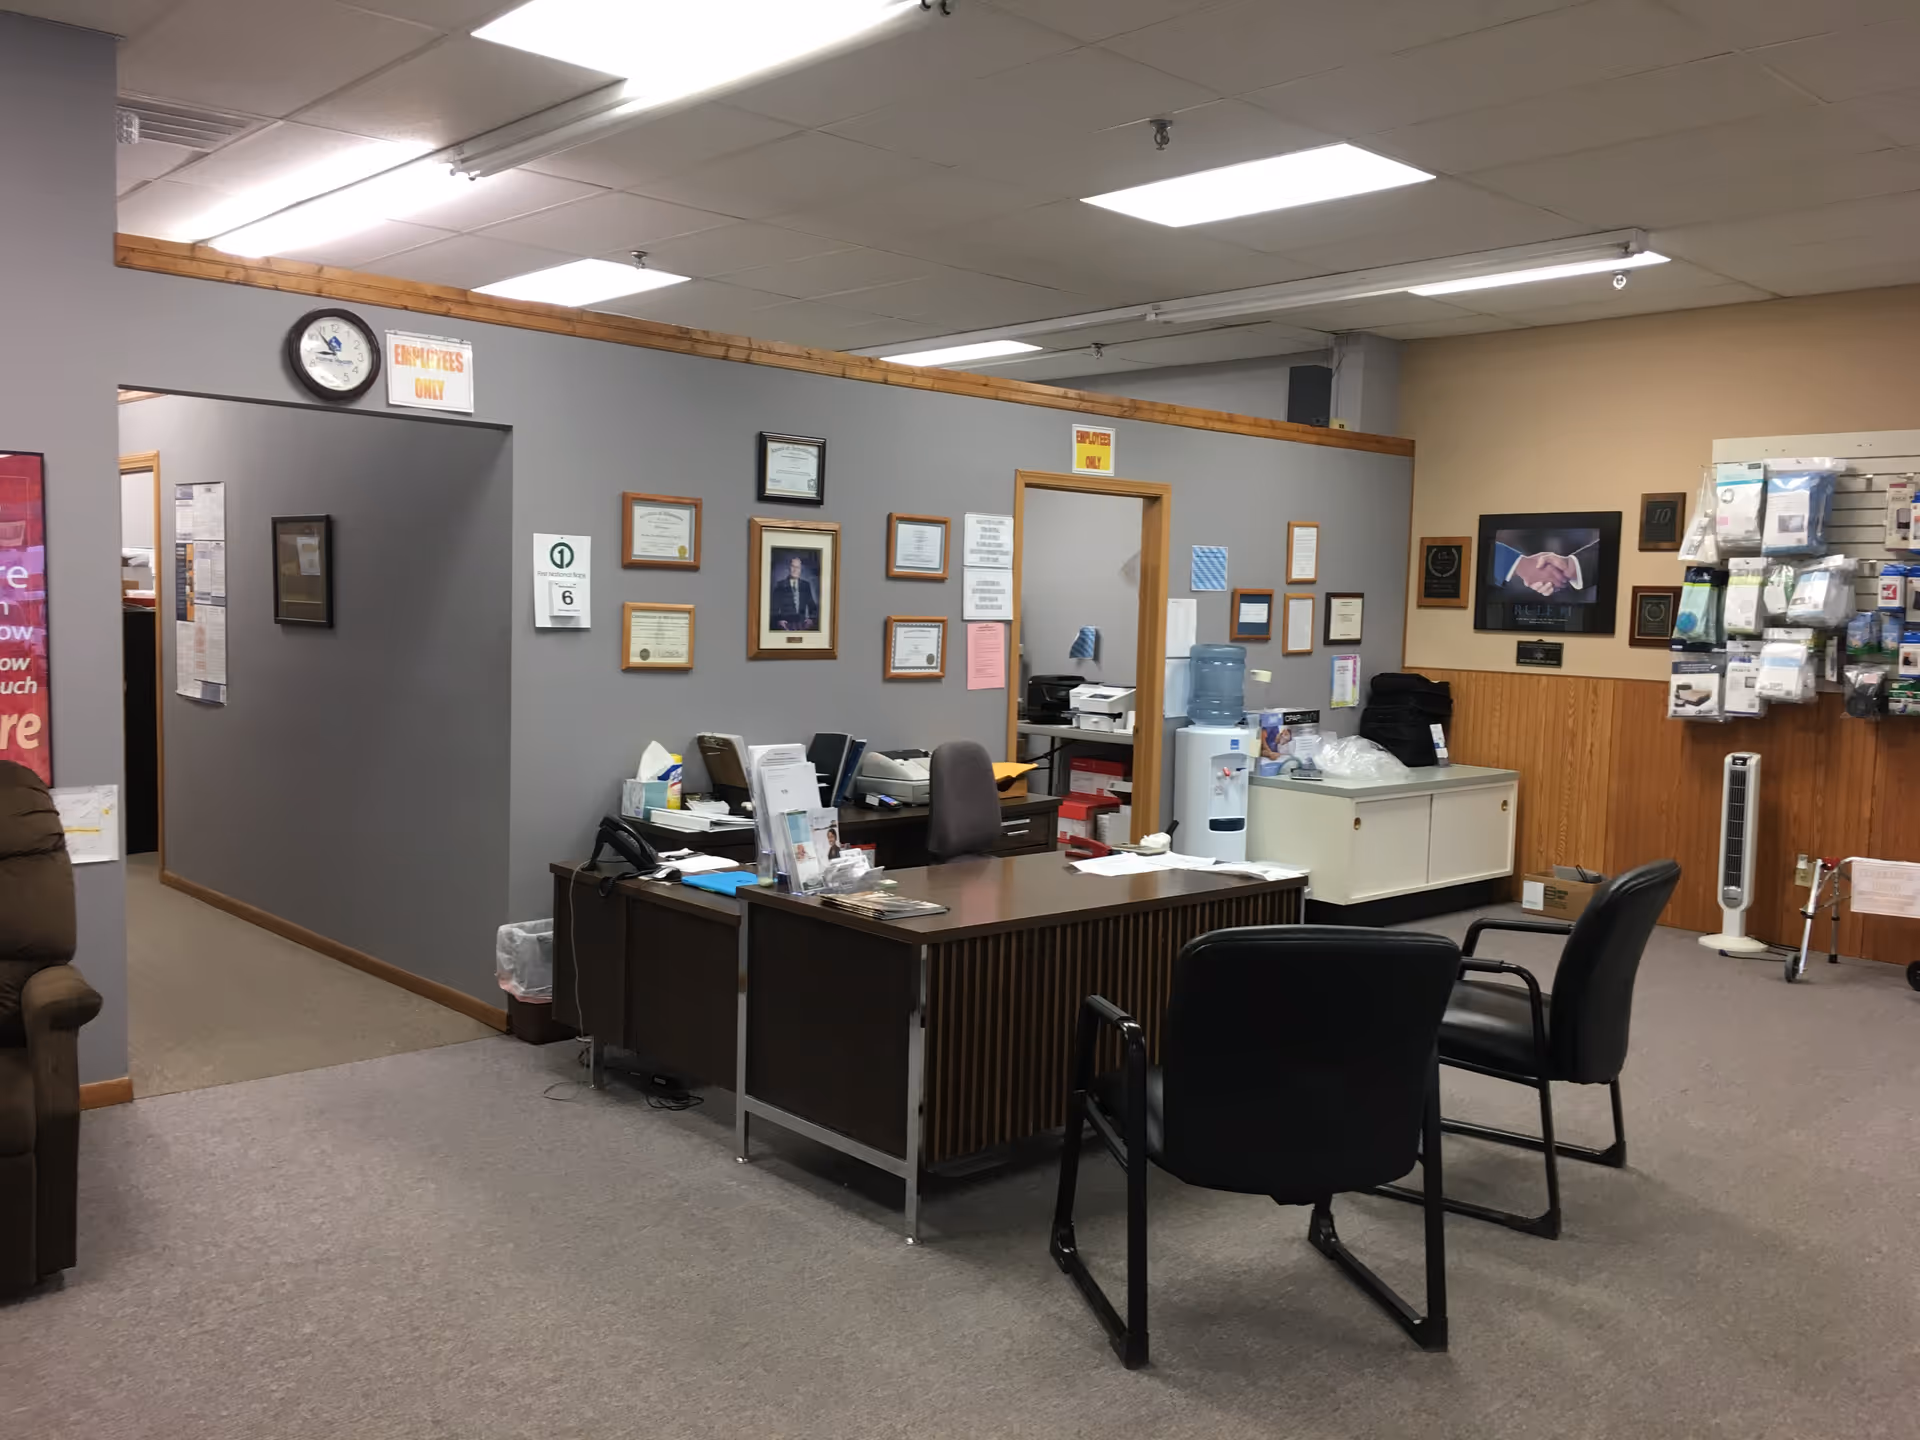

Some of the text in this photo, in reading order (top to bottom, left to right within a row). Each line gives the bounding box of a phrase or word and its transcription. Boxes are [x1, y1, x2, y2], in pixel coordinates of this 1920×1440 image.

[330, 323, 339, 334] 12
[353, 340, 360, 350] 2
[357, 352, 364, 362] 3
[394, 344, 464, 373] EMPLOYEES
[352, 366, 359, 374] 4
[343, 372, 350, 383] 5
[415, 377, 445, 401] ONLY
[1076, 430, 1111, 446] EMPLOYEES
[1086, 456, 1101, 469] ONLY
[1651, 508, 1672, 524] 10
[562, 590, 573, 605] 6
[0, 657, 31, 671] ow
[0, 676, 38, 694] uch
